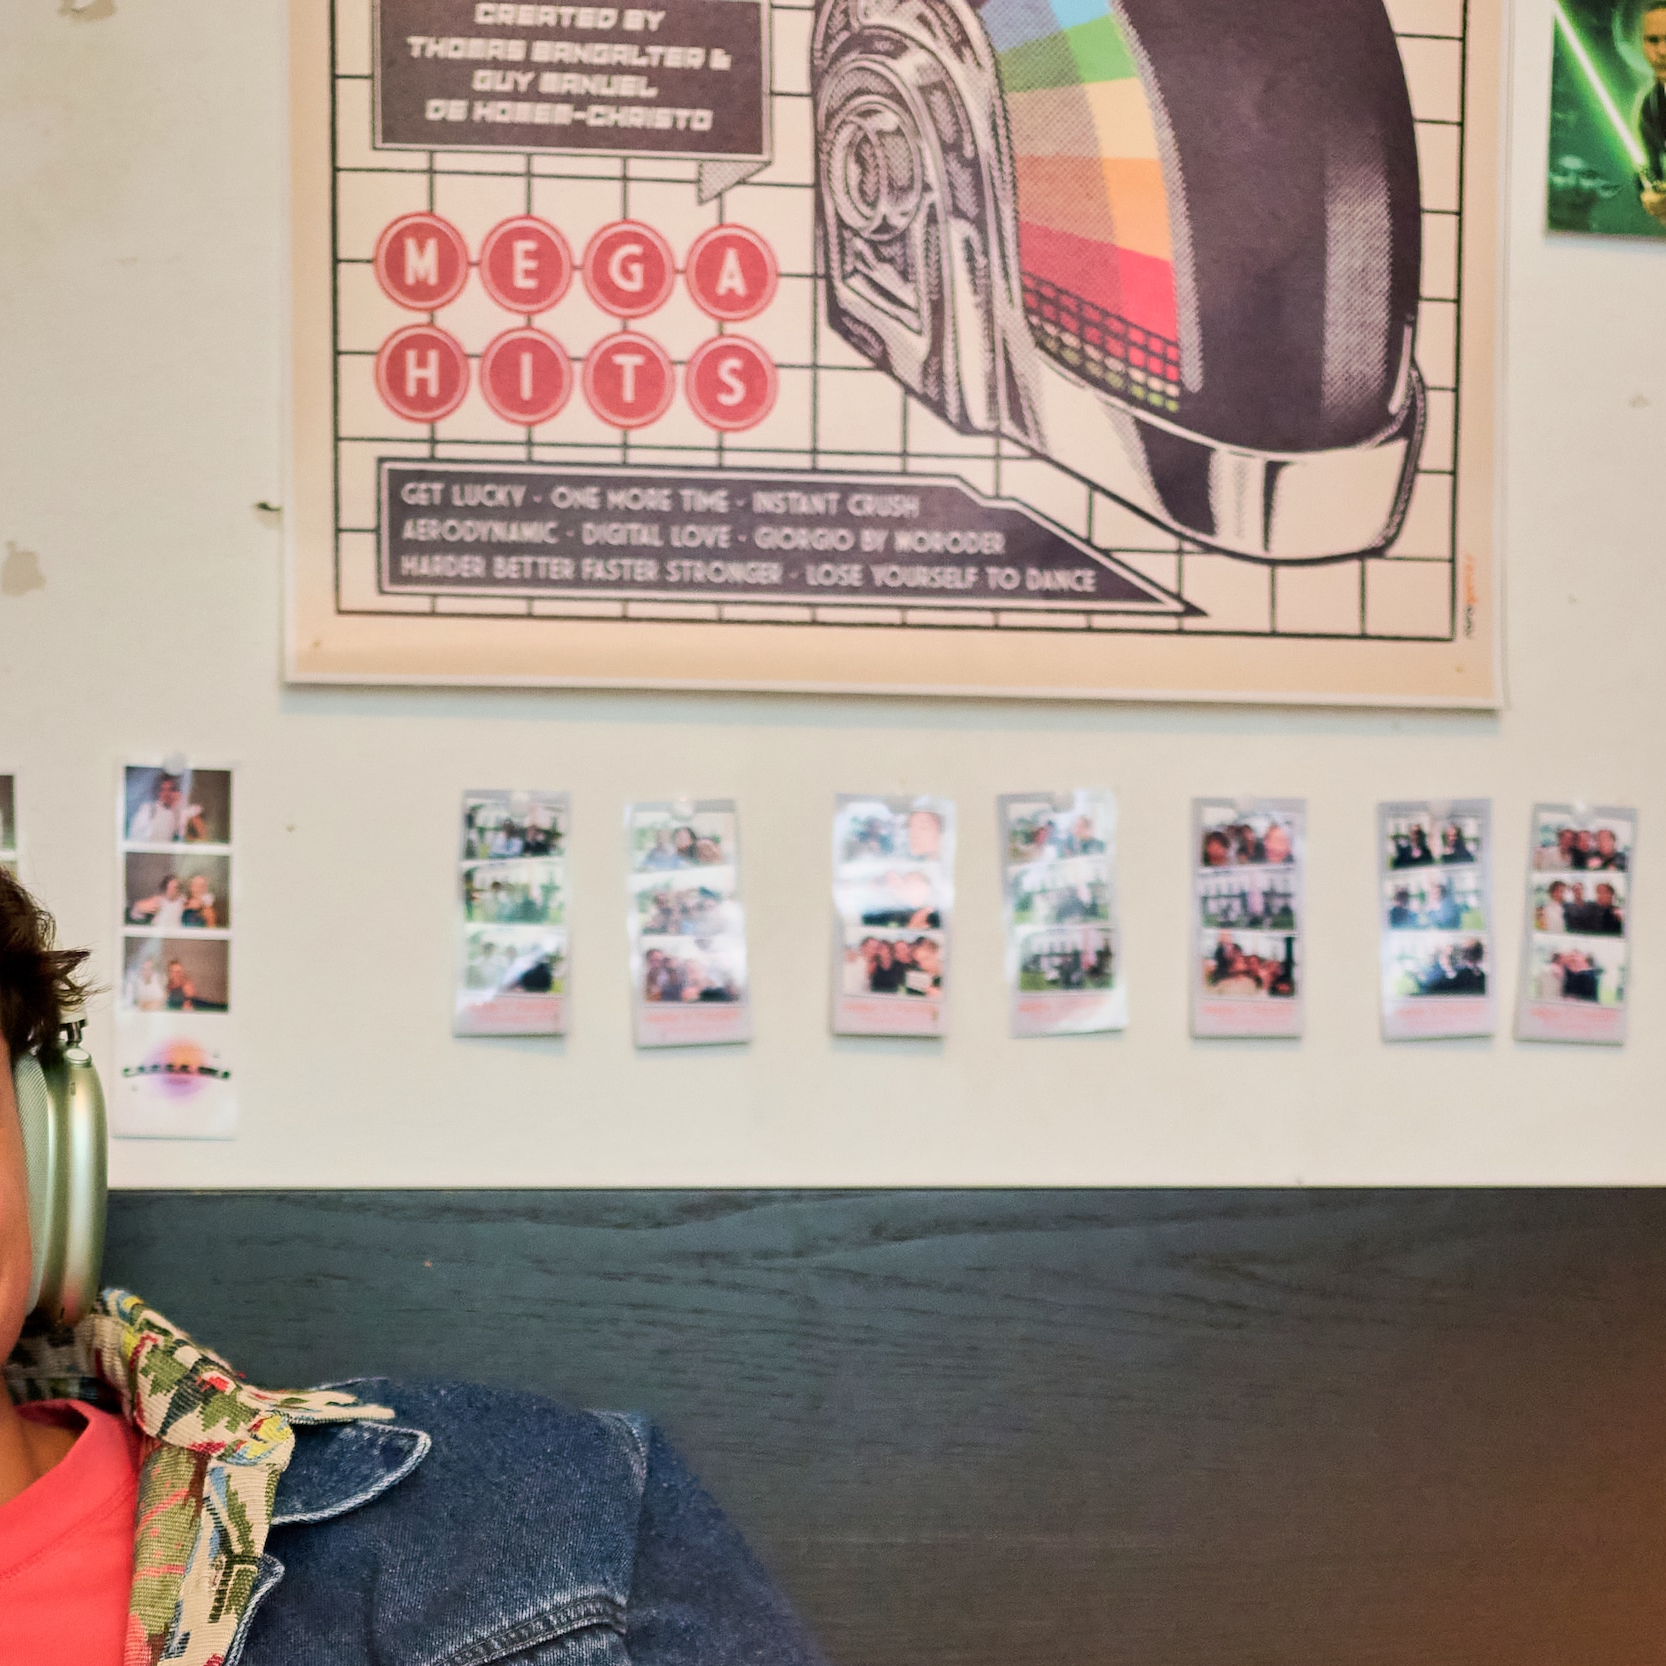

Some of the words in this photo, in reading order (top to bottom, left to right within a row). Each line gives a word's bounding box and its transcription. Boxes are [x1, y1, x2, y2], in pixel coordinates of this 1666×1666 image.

[474, 2, 619, 29] CREATED
[622, 10, 666, 32] BY
[406, 35, 527, 62] THOMAS
[530, 39, 705, 70] BANGALTER
[709, 48, 732, 71] &
[471, 69, 534, 93] GUY
[538, 71, 659, 99] MANUEL
[425, 99, 469, 122] DE
[404, 236, 747, 297] MEGA
[405, 348, 746, 406] HITS
[400, 482, 444, 506] GET
[451, 484, 527, 508] LUCKY
[550, 485, 601, 510] ONE
[606, 487, 672, 512] MORE
[678, 488, 730, 513] TIME
[752, 491, 841, 515] INSTANT
[846, 494, 920, 519] CRUSH
[402, 518, 559, 544] AERODYNAMIC
[582, 522, 664, 548] DIGITAL
[670, 524, 732, 549] LOVE
[753, 526, 855, 552] GIORGIO
[860, 529, 889, 553] BY
[894, 530, 1006, 555] MORODER
[400, 554, 486, 579] HARDER
[493, 556, 575, 580] BETTER
[581, 557, 659, 582] FASTER
[665, 559, 784, 585] STRONGER
[805, 563, 864, 587] LOSE
[869, 565, 979, 590] YOURSELF
[987, 566, 1020, 590] TO
[1025, 567, 1097, 593] DANCE
